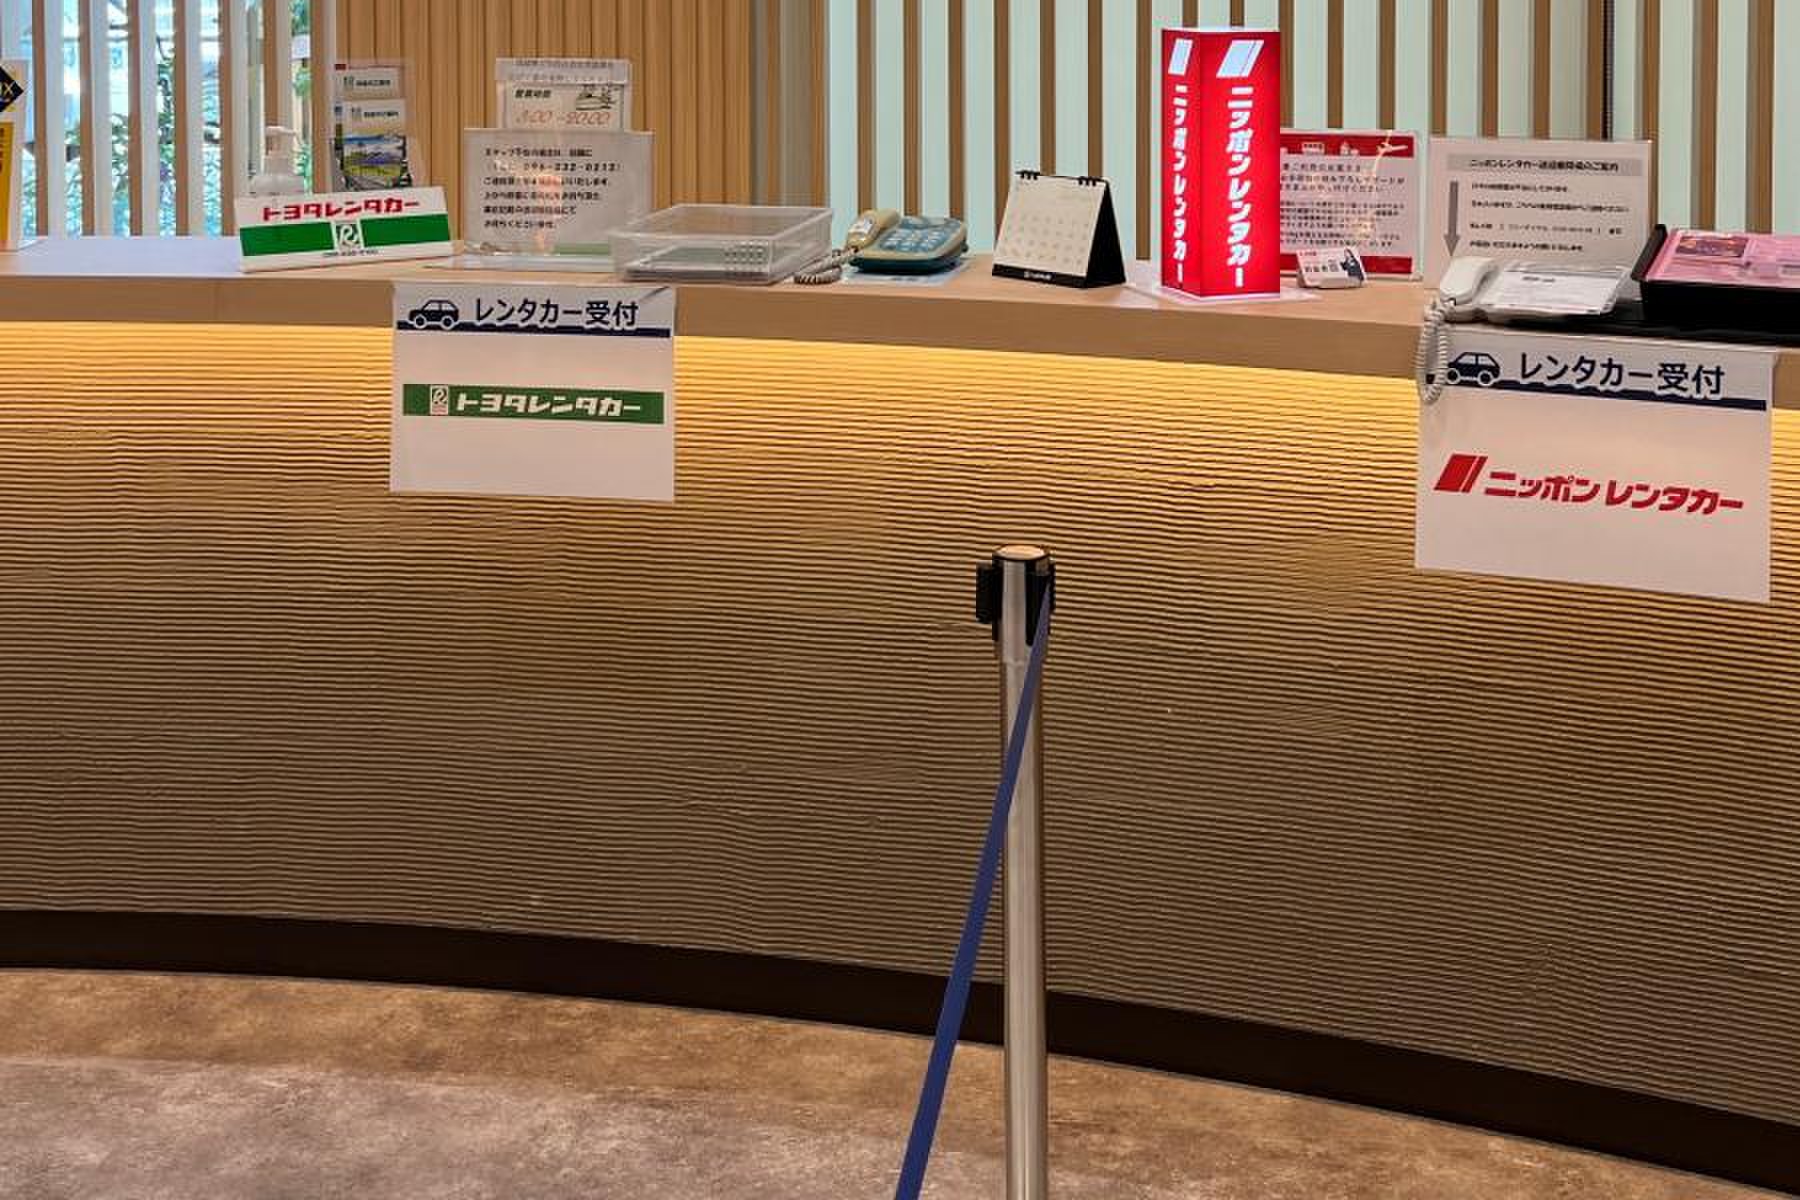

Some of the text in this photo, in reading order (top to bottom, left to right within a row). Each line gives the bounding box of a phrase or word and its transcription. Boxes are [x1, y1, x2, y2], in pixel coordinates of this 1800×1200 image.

[1172, 83, 1188, 283] ニッポンレンタカー
[1225, 85, 1254, 289] ニッポンレンタカー
[262, 198, 420, 222] トヨタレンタカー
[475, 298, 639, 328] レンタカー受付
[1520, 352, 1725, 395] レンタカー受付
[456, 391, 641, 417] トヨタレンタカー
[1484, 471, 1744, 515] ニッポンレンタカー
